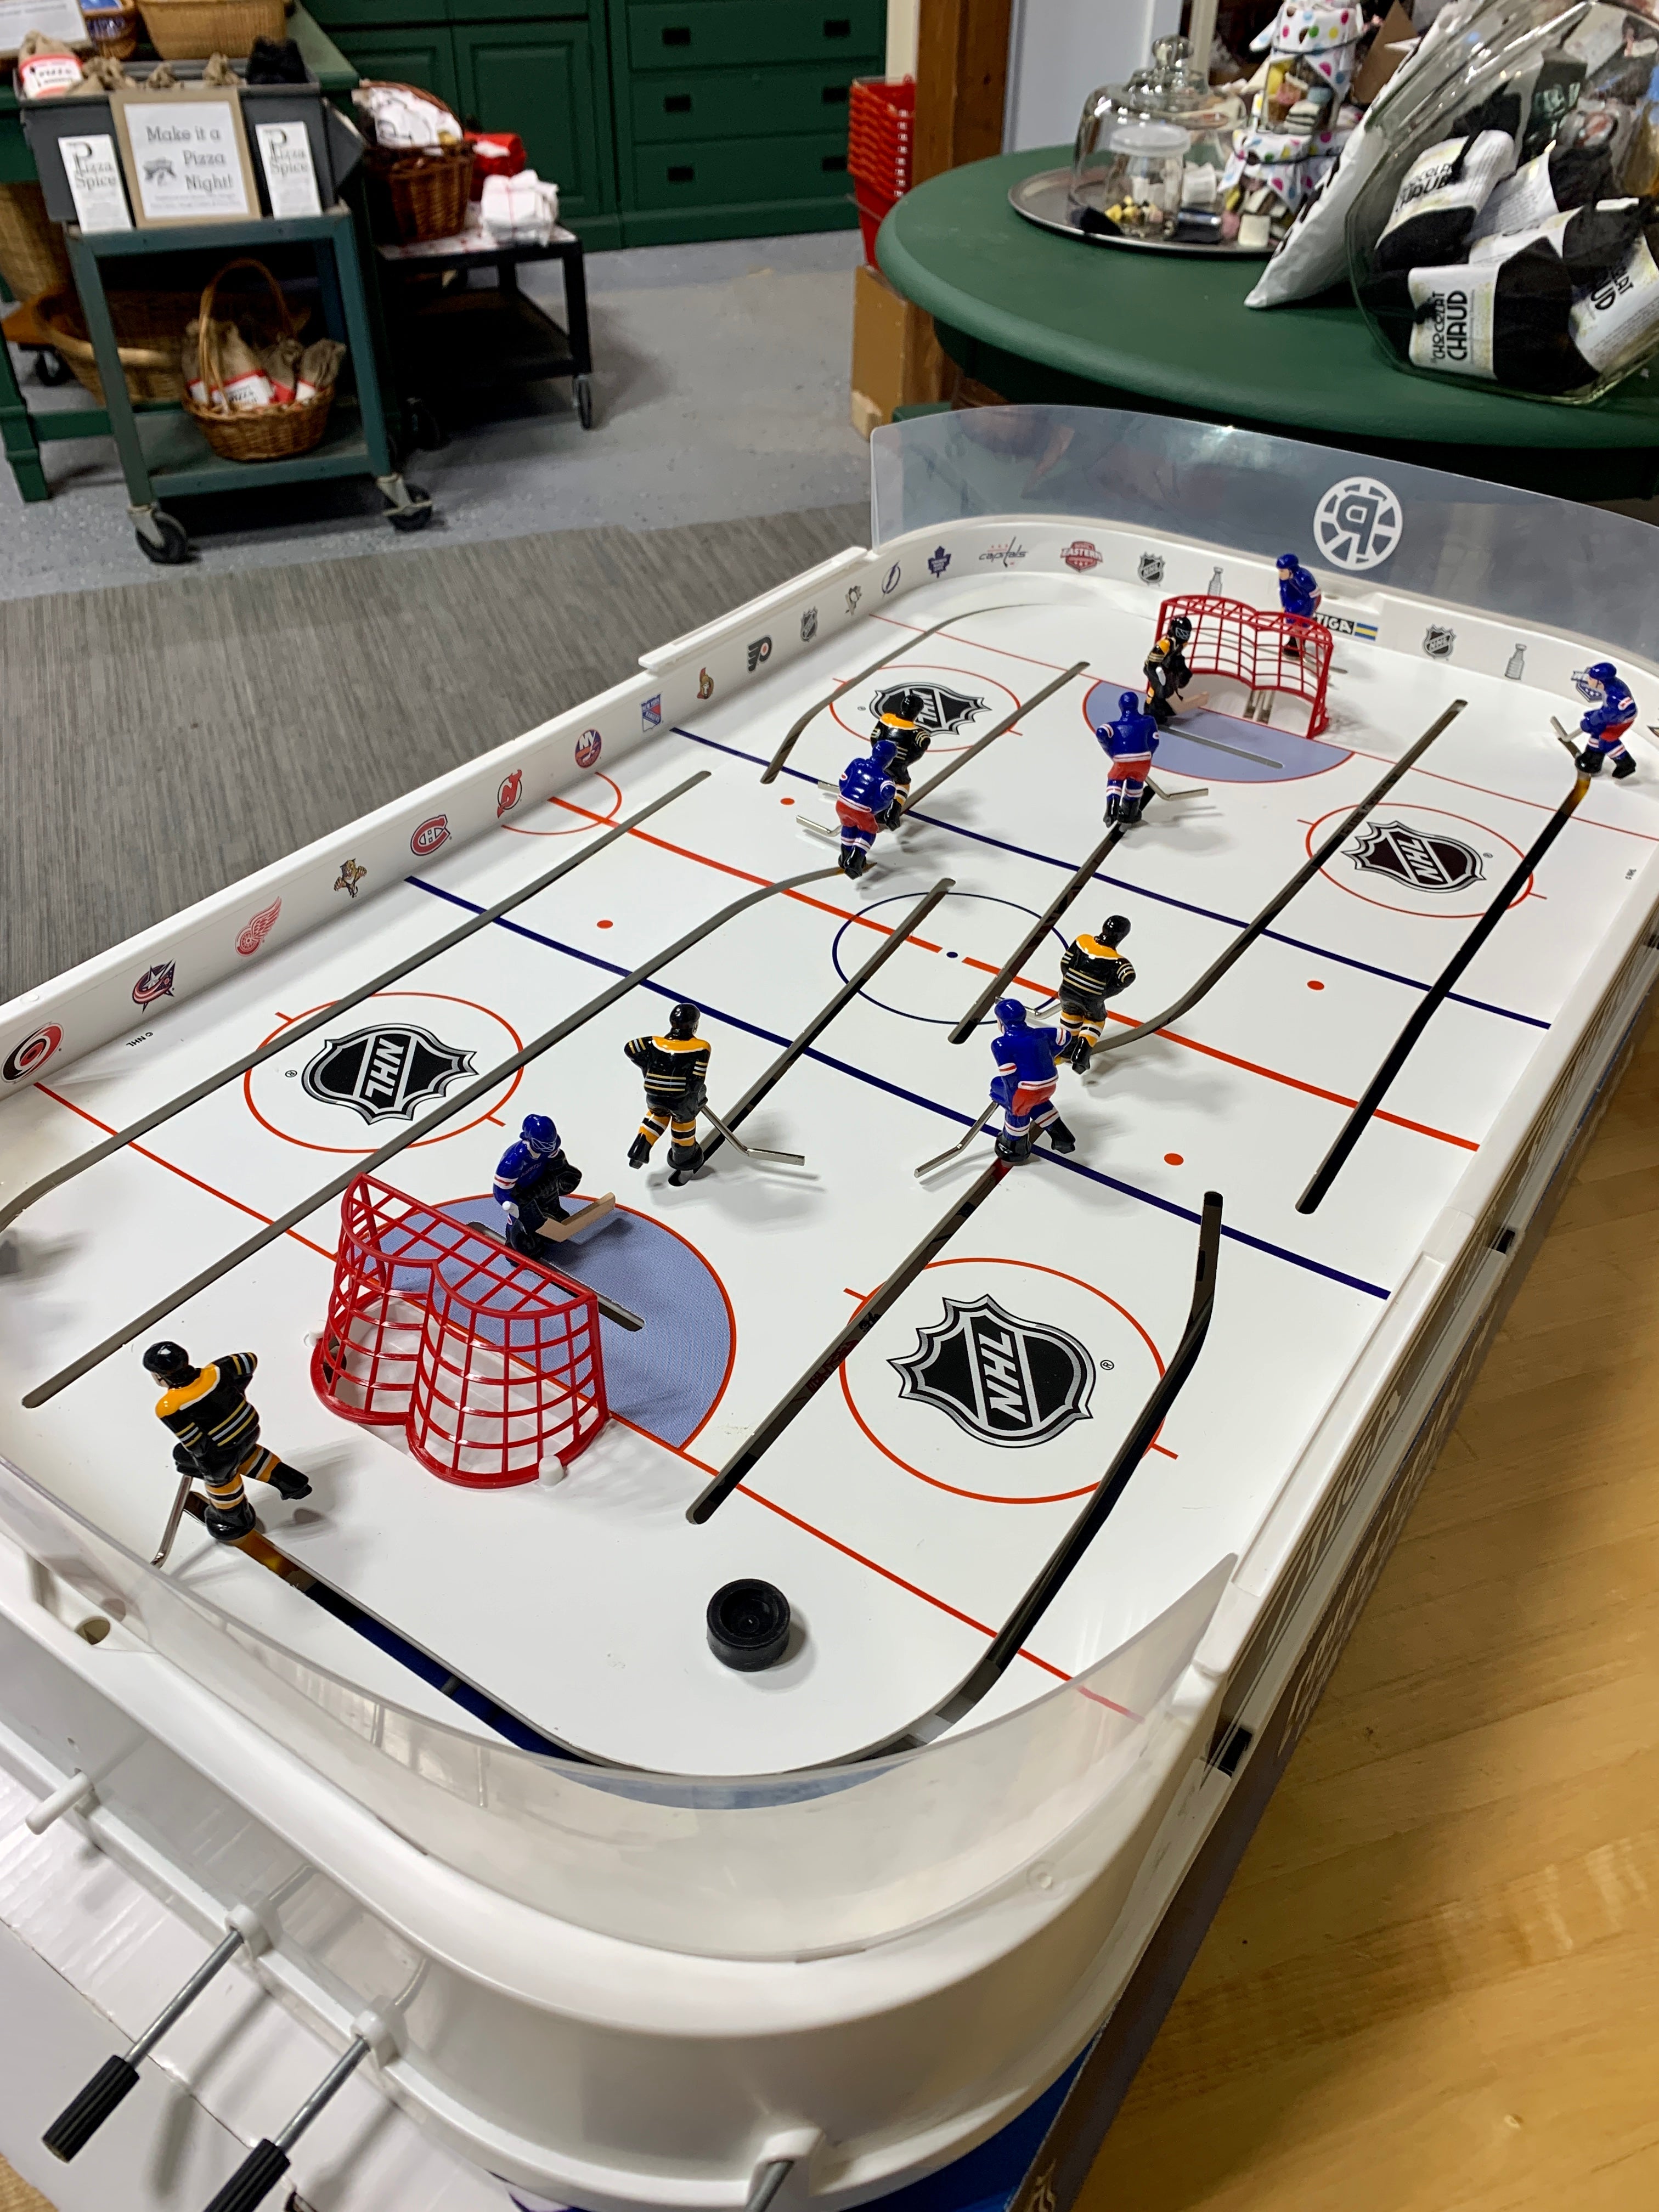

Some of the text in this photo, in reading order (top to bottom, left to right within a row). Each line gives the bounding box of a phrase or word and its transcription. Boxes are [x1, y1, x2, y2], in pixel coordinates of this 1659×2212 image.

[146, 125, 221, 141] Make it a
[183, 149, 225, 165] Pizza
[269, 162, 308, 178] Spice
[75, 174, 116, 191] Spice
[1446, 290, 1468, 361] CHAUD
[1061, 548, 1103, 562] EASTERN
[1314, 614, 1352, 634] TIGA
[1397, 838, 1444, 882] NHL
[126, 1036, 146, 1046] NHL
[365, 1037, 404, 1098] NHL
[978, 1331, 1026, 1423] NHL
